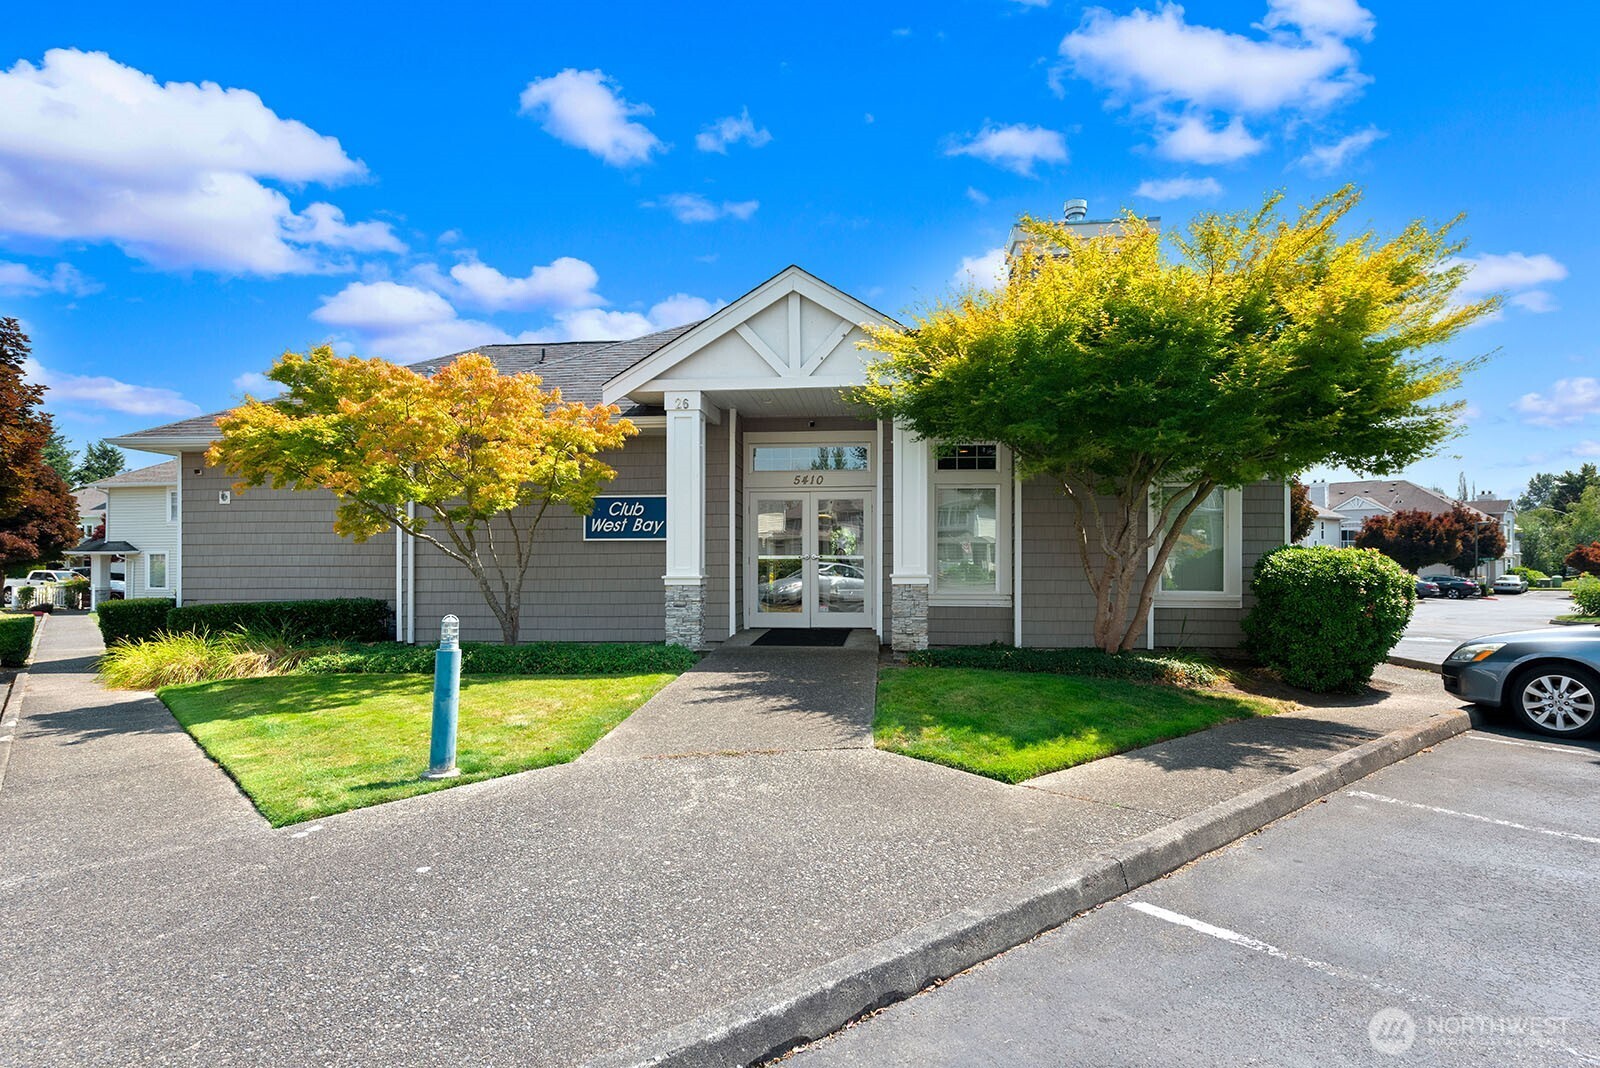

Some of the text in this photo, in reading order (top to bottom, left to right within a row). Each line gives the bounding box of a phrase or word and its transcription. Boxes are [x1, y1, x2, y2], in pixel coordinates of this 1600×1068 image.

[674, 398, 690, 409] 26
[793, 474, 824, 485] 5410
[608, 501, 645, 516] Club
[591, 518, 665, 535] West Bay
